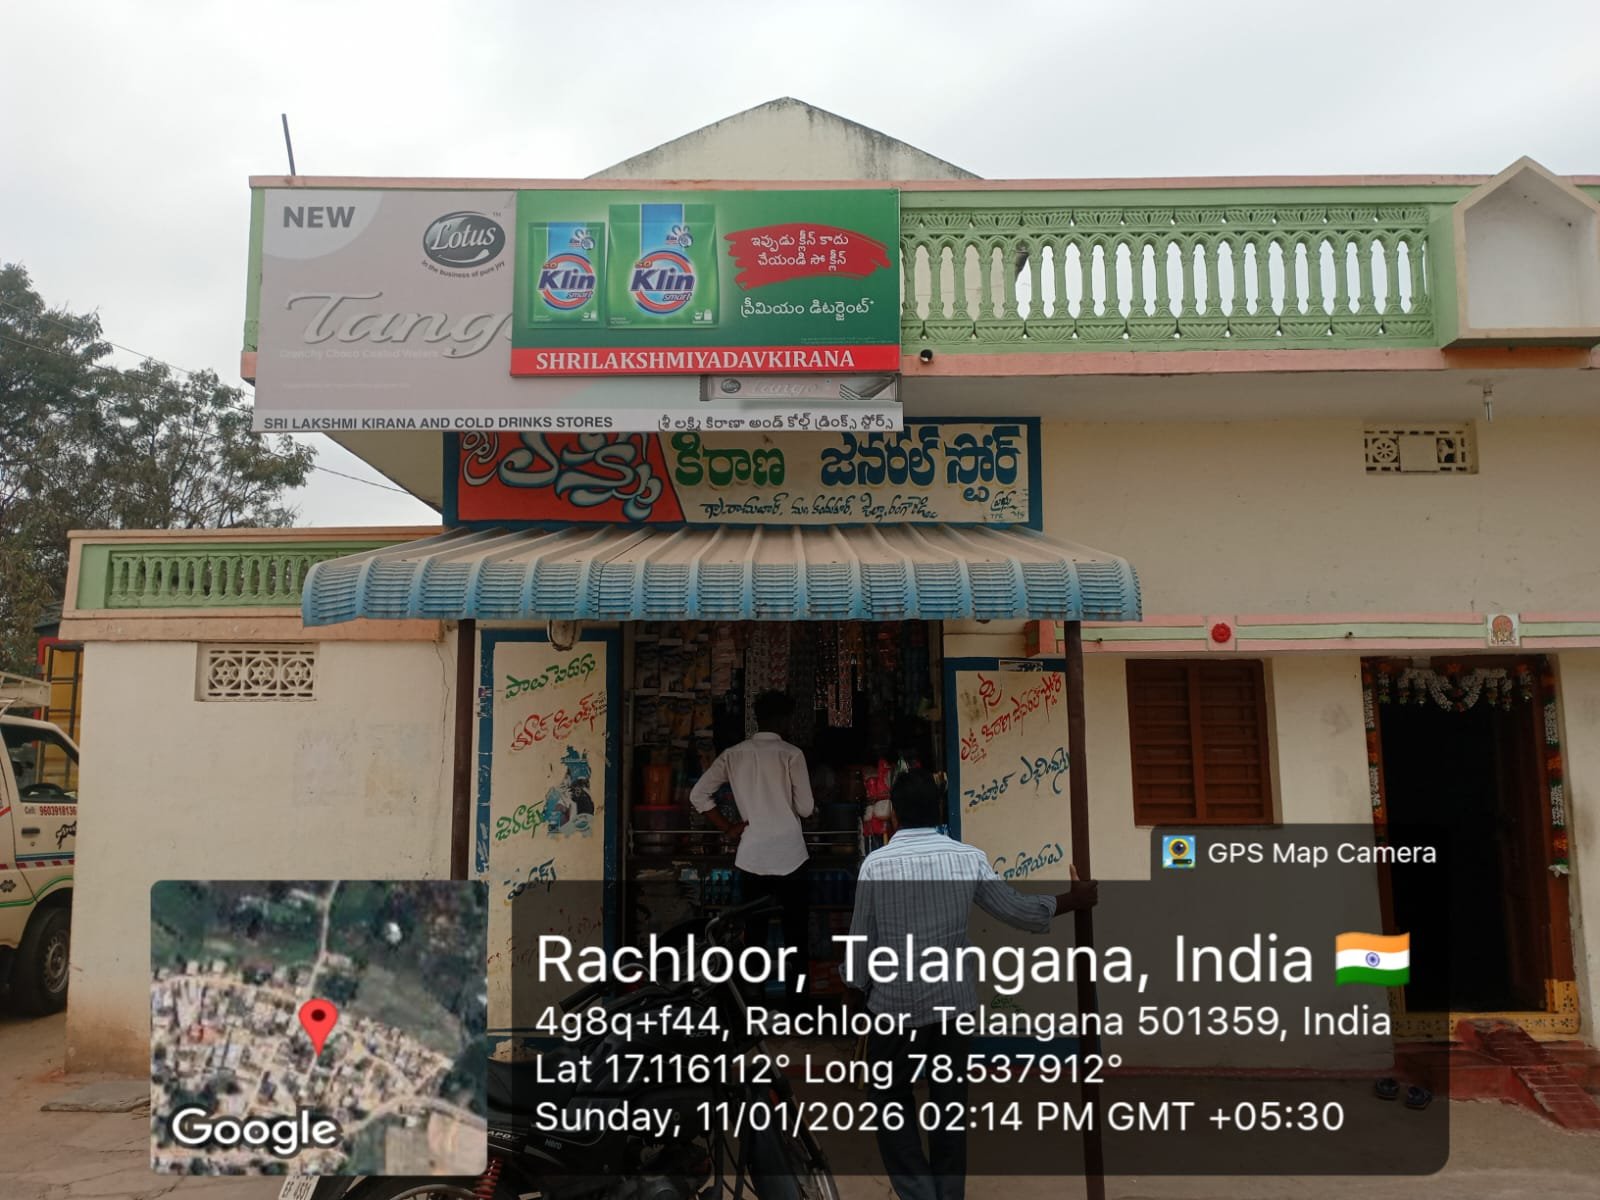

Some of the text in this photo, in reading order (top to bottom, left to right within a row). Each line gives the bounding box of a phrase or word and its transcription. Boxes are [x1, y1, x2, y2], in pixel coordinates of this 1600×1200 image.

[282, 206, 356, 228] NEW
[431, 223, 496, 251] Lotus
[751, 234, 795, 252] ఇప్పుడు
[819, 233, 849, 245] కాదు
[428, 264, 439, 273] the
[440, 269, 470, 278] business
[480, 266, 495, 277] pure
[494, 260, 505, 272] joy
[758, 251, 807, 265] చేయండి
[810, 253, 826, 265] సో
[538, 267, 596, 290] Klin
[630, 267, 696, 292] Klin
[662, 290, 692, 302] smart
[740, 296, 805, 319] ప్రీమియం
[286, 291, 513, 359] Tang
[535, 349, 855, 371] SHRILAKSHMIYADAVKIRANA
[263, 416, 613, 430] SRI LAKSHMI KIRANA AND COLD DRINKS STORES
[658, 413, 671, 431] శ్రీ
[706, 416, 745, 429] కిరాణా
[749, 415, 783, 429] అండ్
[815, 413, 857, 431] డ్రింక్స్
[504, 673, 549, 699] పాలు
